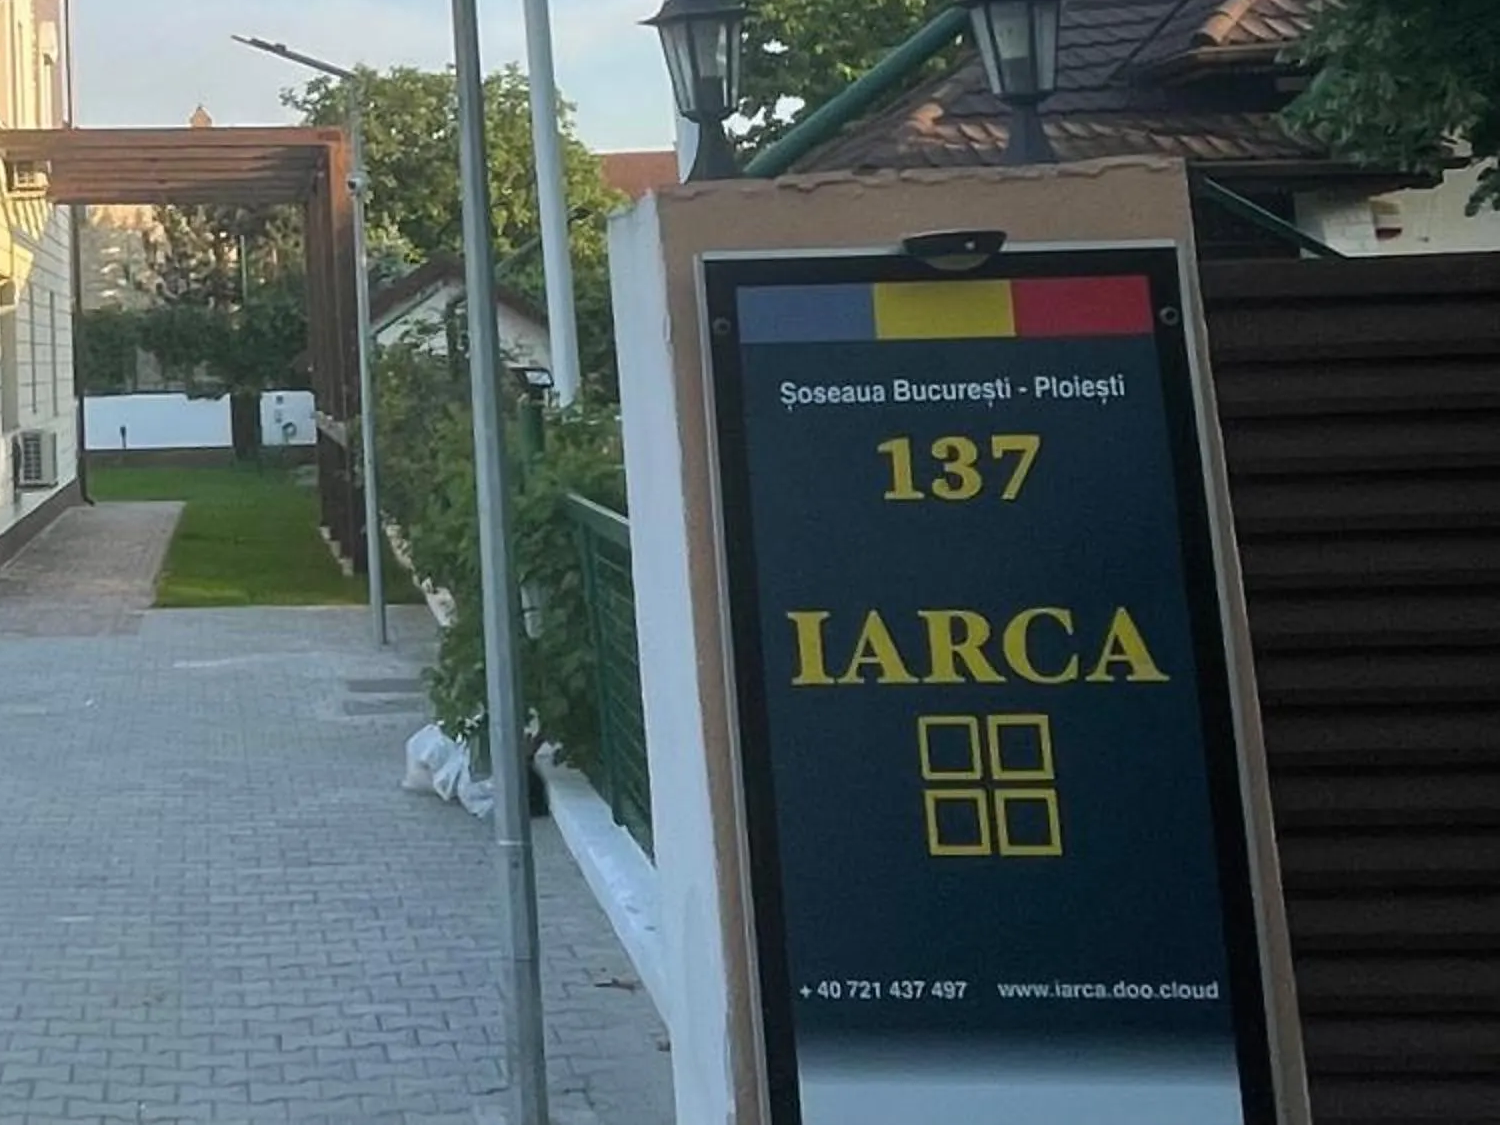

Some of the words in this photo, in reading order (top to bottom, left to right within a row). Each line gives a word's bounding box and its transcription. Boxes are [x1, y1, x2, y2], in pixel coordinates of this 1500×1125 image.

[780, 382, 885, 412] Șoseaua
[893, 377, 1012, 408] București
[1035, 374, 1126, 405] Ploiești
[877, 434, 1041, 501] 137
[786, 606, 1170, 686] IARCA
[817, 980, 841, 999] 40
[846, 980, 881, 999] 721
[889, 980, 925, 999] 437
[931, 980, 967, 1000] 497
[998, 980, 1219, 1000] www.iarca.doo.cloud
